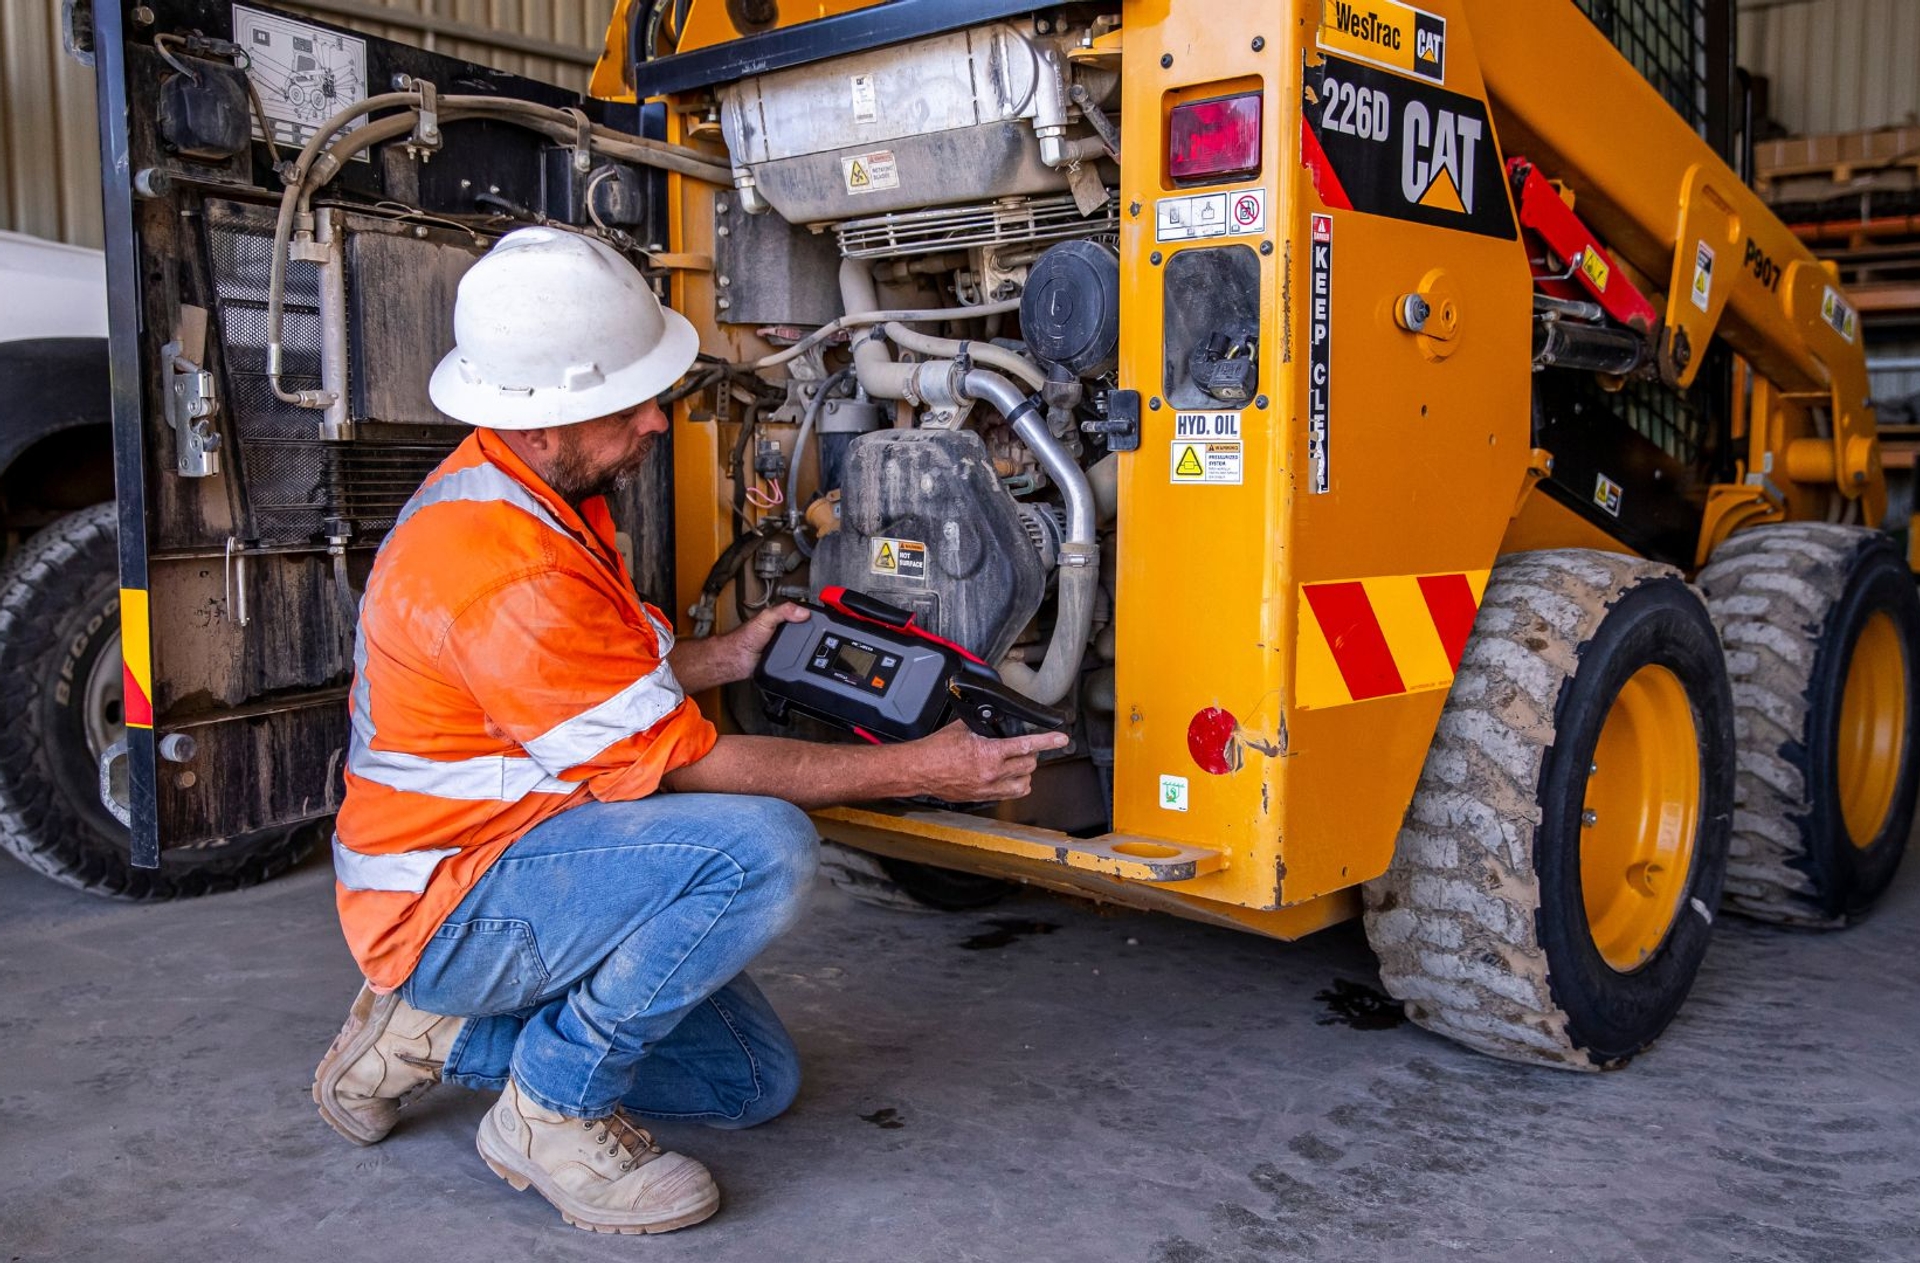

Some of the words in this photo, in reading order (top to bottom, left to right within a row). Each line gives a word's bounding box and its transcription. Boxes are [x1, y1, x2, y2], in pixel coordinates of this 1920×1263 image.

[1336, 1, 1400, 50] WesTrac
[1417, 28, 1443, 64] CAT
[1322, 77, 1390, 142] 226D
[1401, 100, 1482, 215] CAT
[1744, 237, 1781, 293] P907
[1314, 246, 1328, 345] KEEP
[1178, 415, 1210, 435] HYD.
[1214, 415, 1238, 435] OIL
[900, 560, 923, 568] SURFACE
